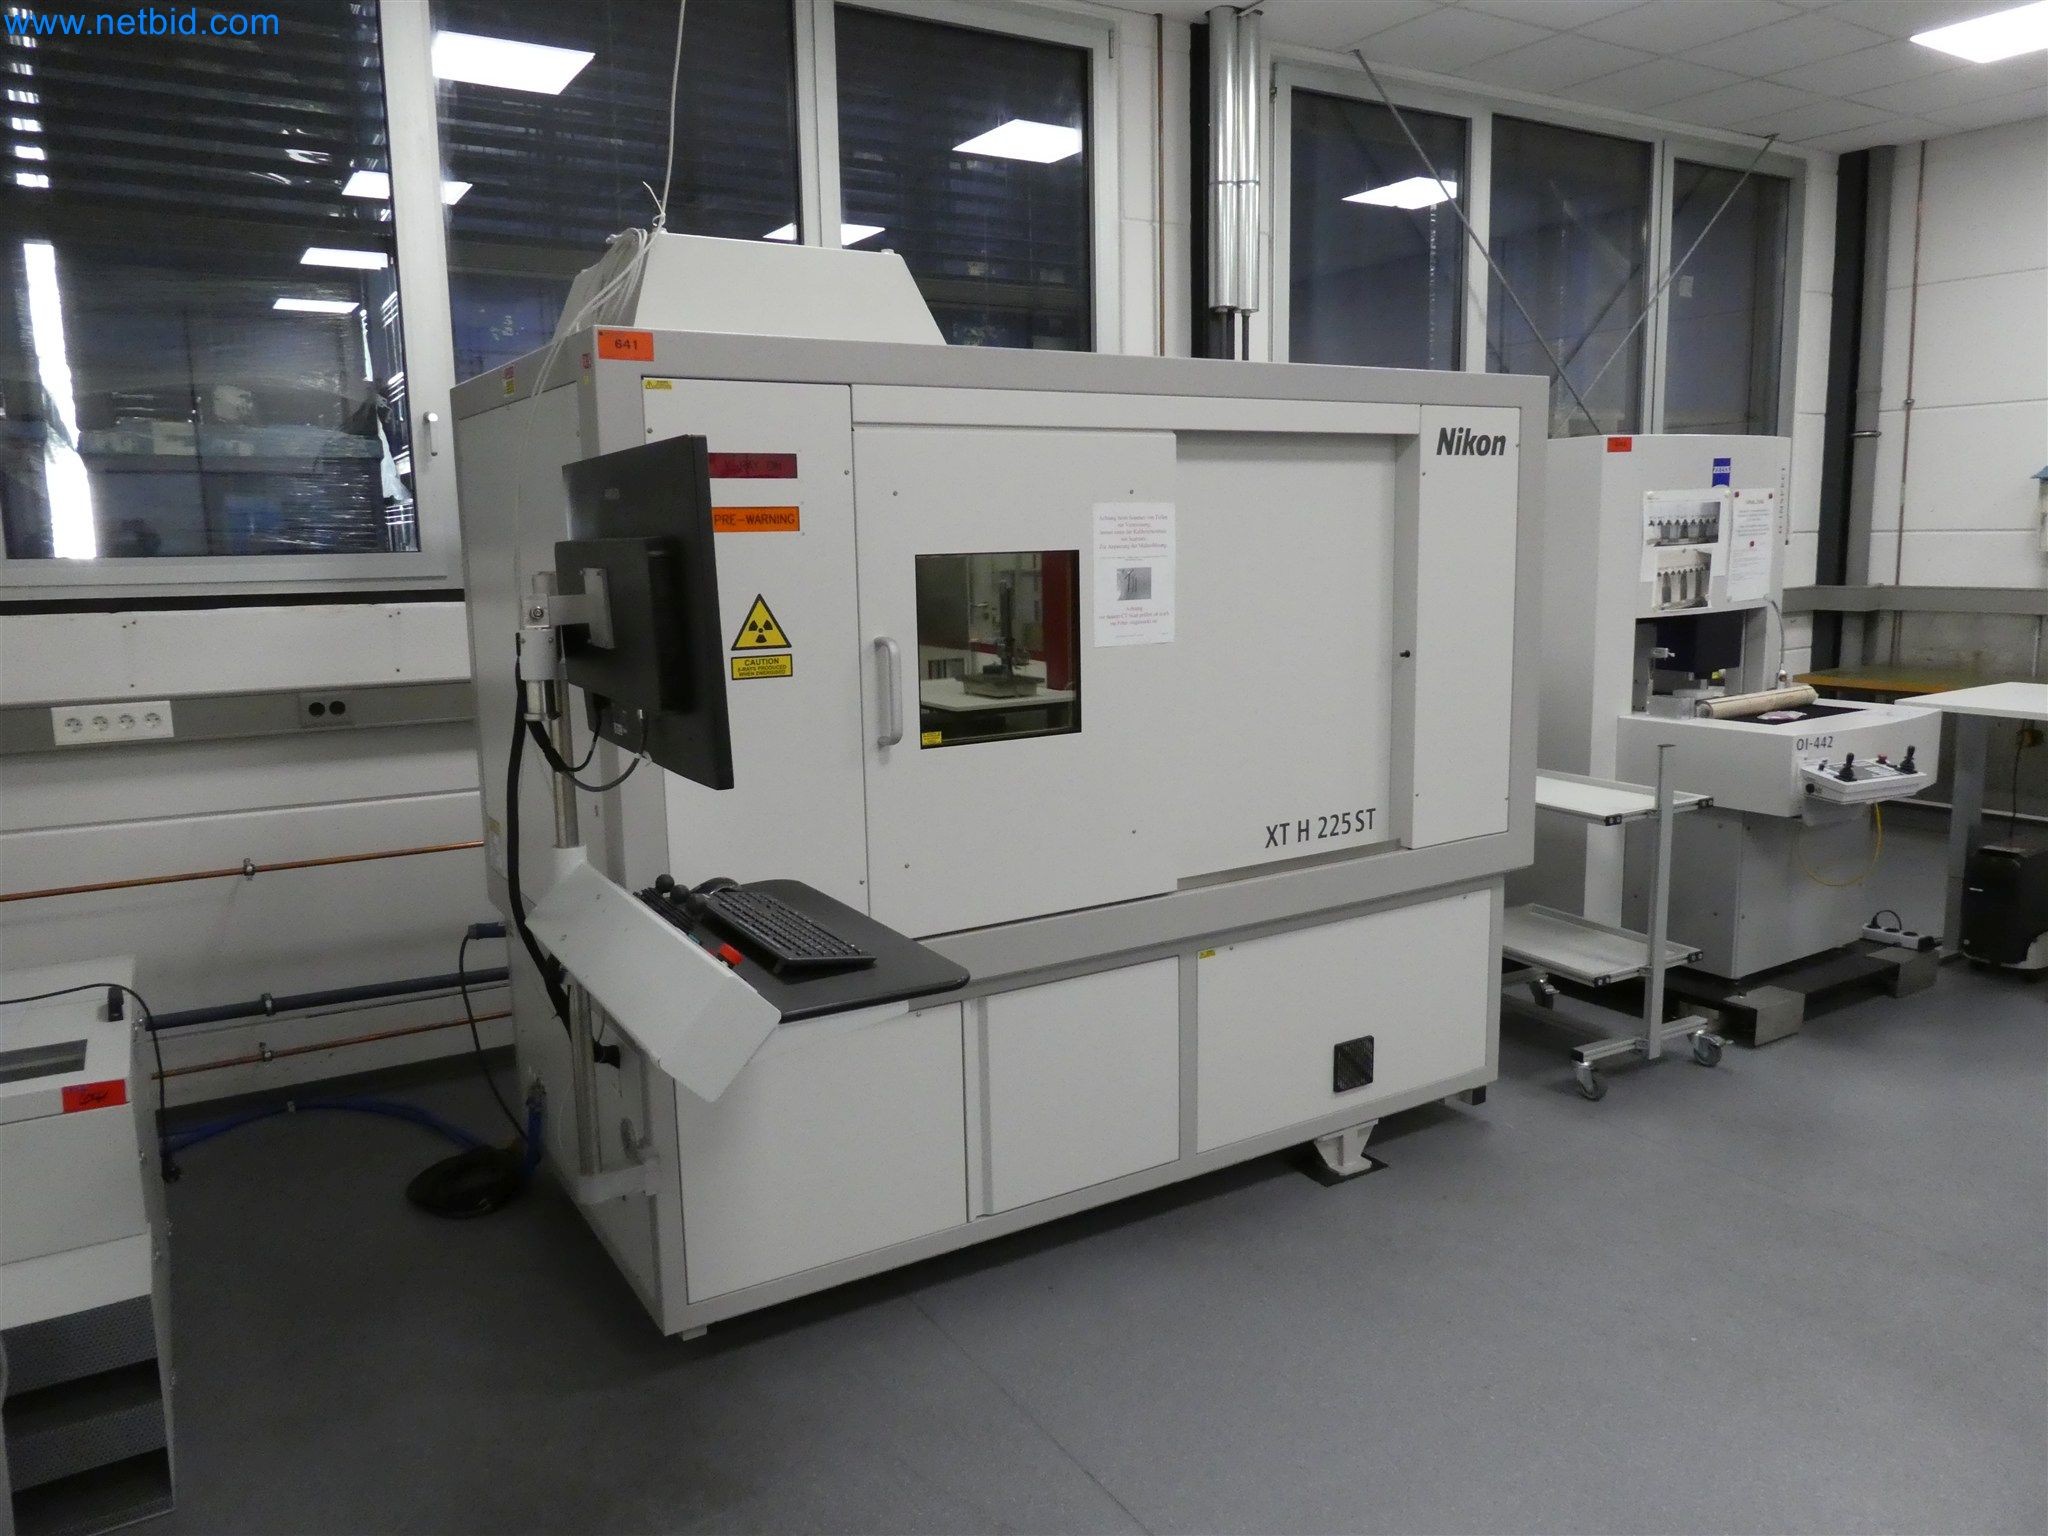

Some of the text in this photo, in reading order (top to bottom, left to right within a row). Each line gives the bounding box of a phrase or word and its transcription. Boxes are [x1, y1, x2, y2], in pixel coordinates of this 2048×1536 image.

[614, 339, 639, 350] 641
[1436, 427, 1506, 456] Nikon
[744, 658, 780, 666] CAUTION
[1265, 823, 1290, 848] XT
[1297, 819, 1310, 843] H
